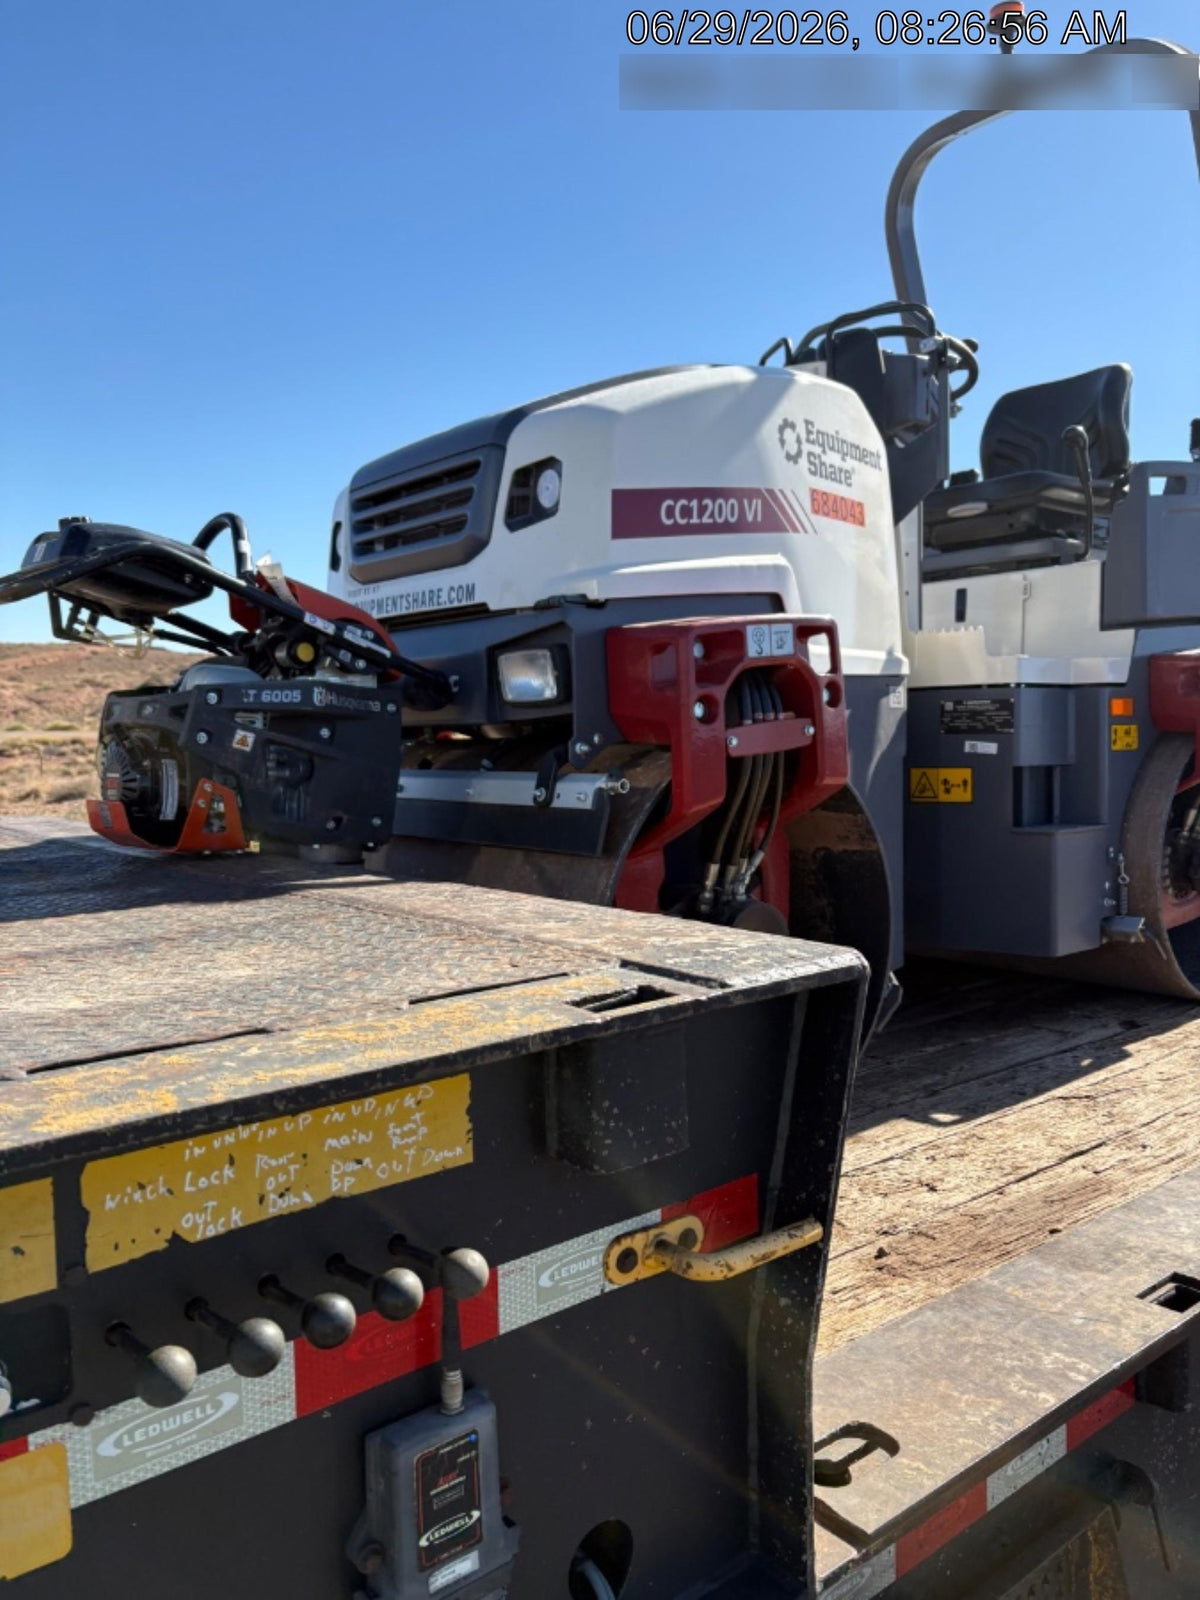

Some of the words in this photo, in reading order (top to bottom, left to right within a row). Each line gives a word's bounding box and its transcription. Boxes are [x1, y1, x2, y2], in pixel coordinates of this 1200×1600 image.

[803, 418, 883, 472] Equipment
[807, 450, 853, 487] Share
[660, 498, 738, 526] CC1200
[744, 499, 762, 522] VI
[810, 489, 865, 527] 684043
[261, 689, 303, 703] 6005
[553, 1256, 604, 1280] LEDWE
[122, 1402, 217, 1448] LEDWELL
